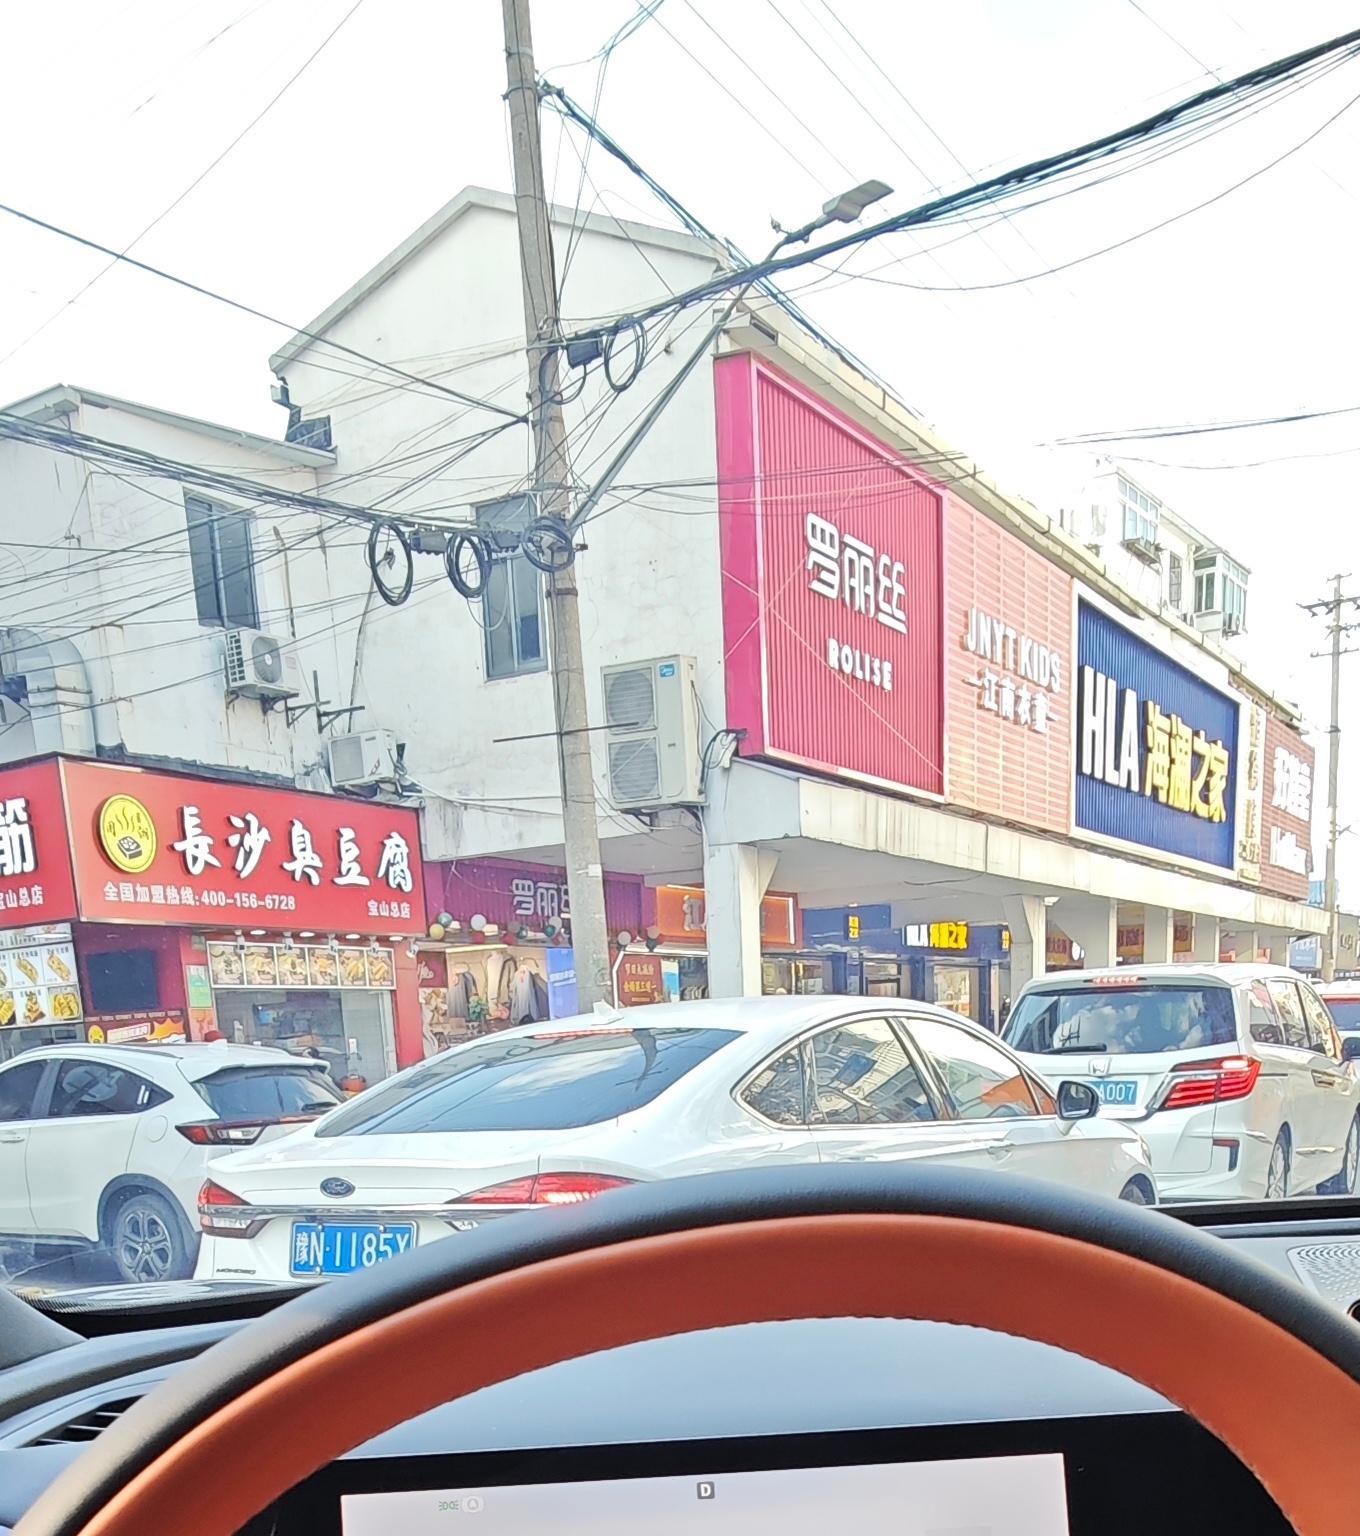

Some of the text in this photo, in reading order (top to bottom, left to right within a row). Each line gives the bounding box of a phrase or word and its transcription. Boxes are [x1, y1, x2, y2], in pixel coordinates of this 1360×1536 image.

[828, 637, 893, 691] ROLISE
[966, 607, 1061, 694] JNYT KIDS
[1082, 664, 1140, 793] HLA
[1144, 700, 1230, 824] 海澜之家
[103, 881, 296, 911] 全国加盟热线:400-156-6728
[367, 900, 411, 919] 宝山总店
[700, 1483, 713, 1498] D
